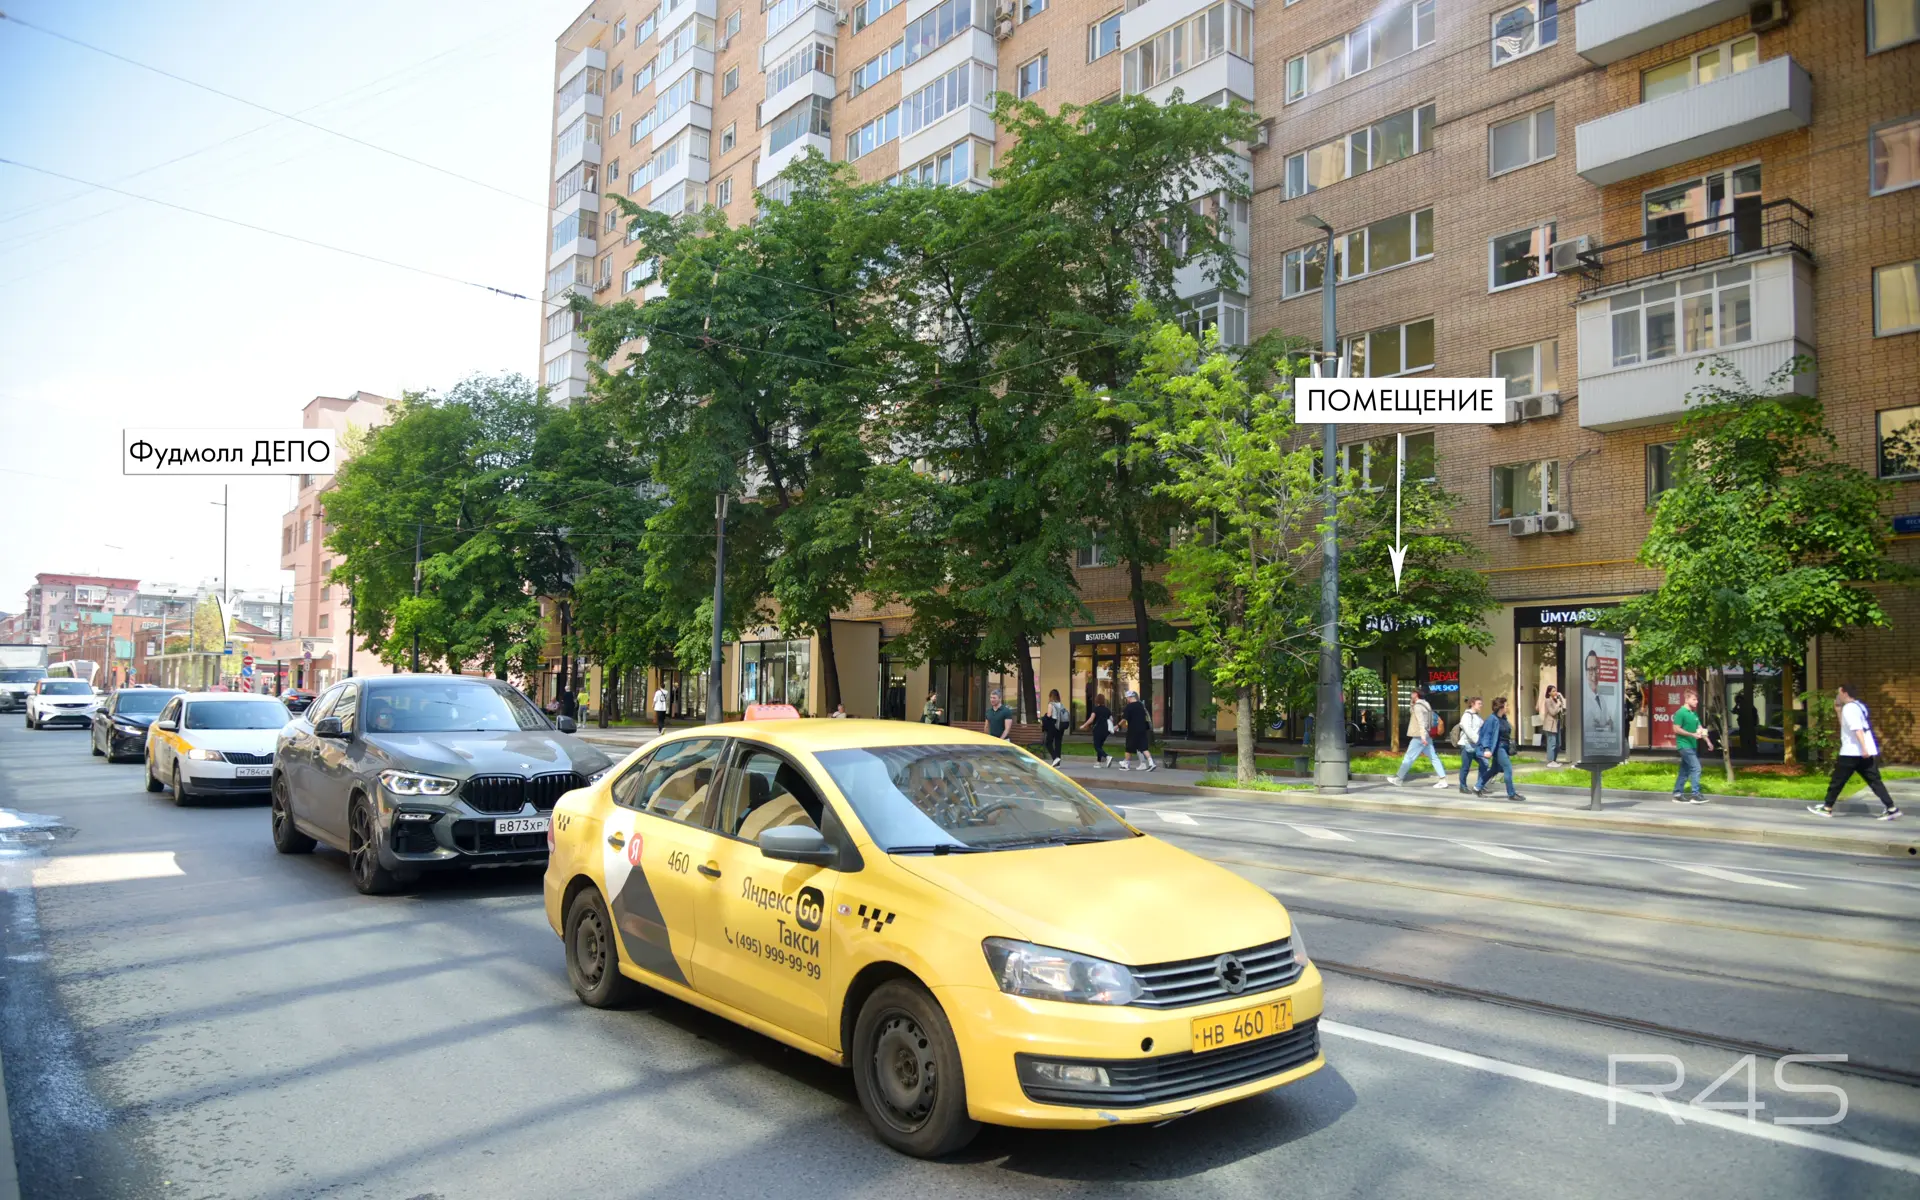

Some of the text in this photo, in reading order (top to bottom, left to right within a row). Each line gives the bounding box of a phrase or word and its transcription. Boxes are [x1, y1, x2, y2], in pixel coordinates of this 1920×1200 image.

[1429, 672, 1458, 681] ТАБАК
[1429, 684, 1458, 692] VAPE SHOP
[1653, 714, 1669, 722] 960
[499, 819, 543, 832] В873ХР
[668, 851, 690, 874] 460
[742, 877, 821, 922] Яндекс Go
[776, 919, 819, 958] Такси
[735, 931, 821, 980] (495) 999-99-99
[1203, 1003, 1287, 1047] НВ 460 77
